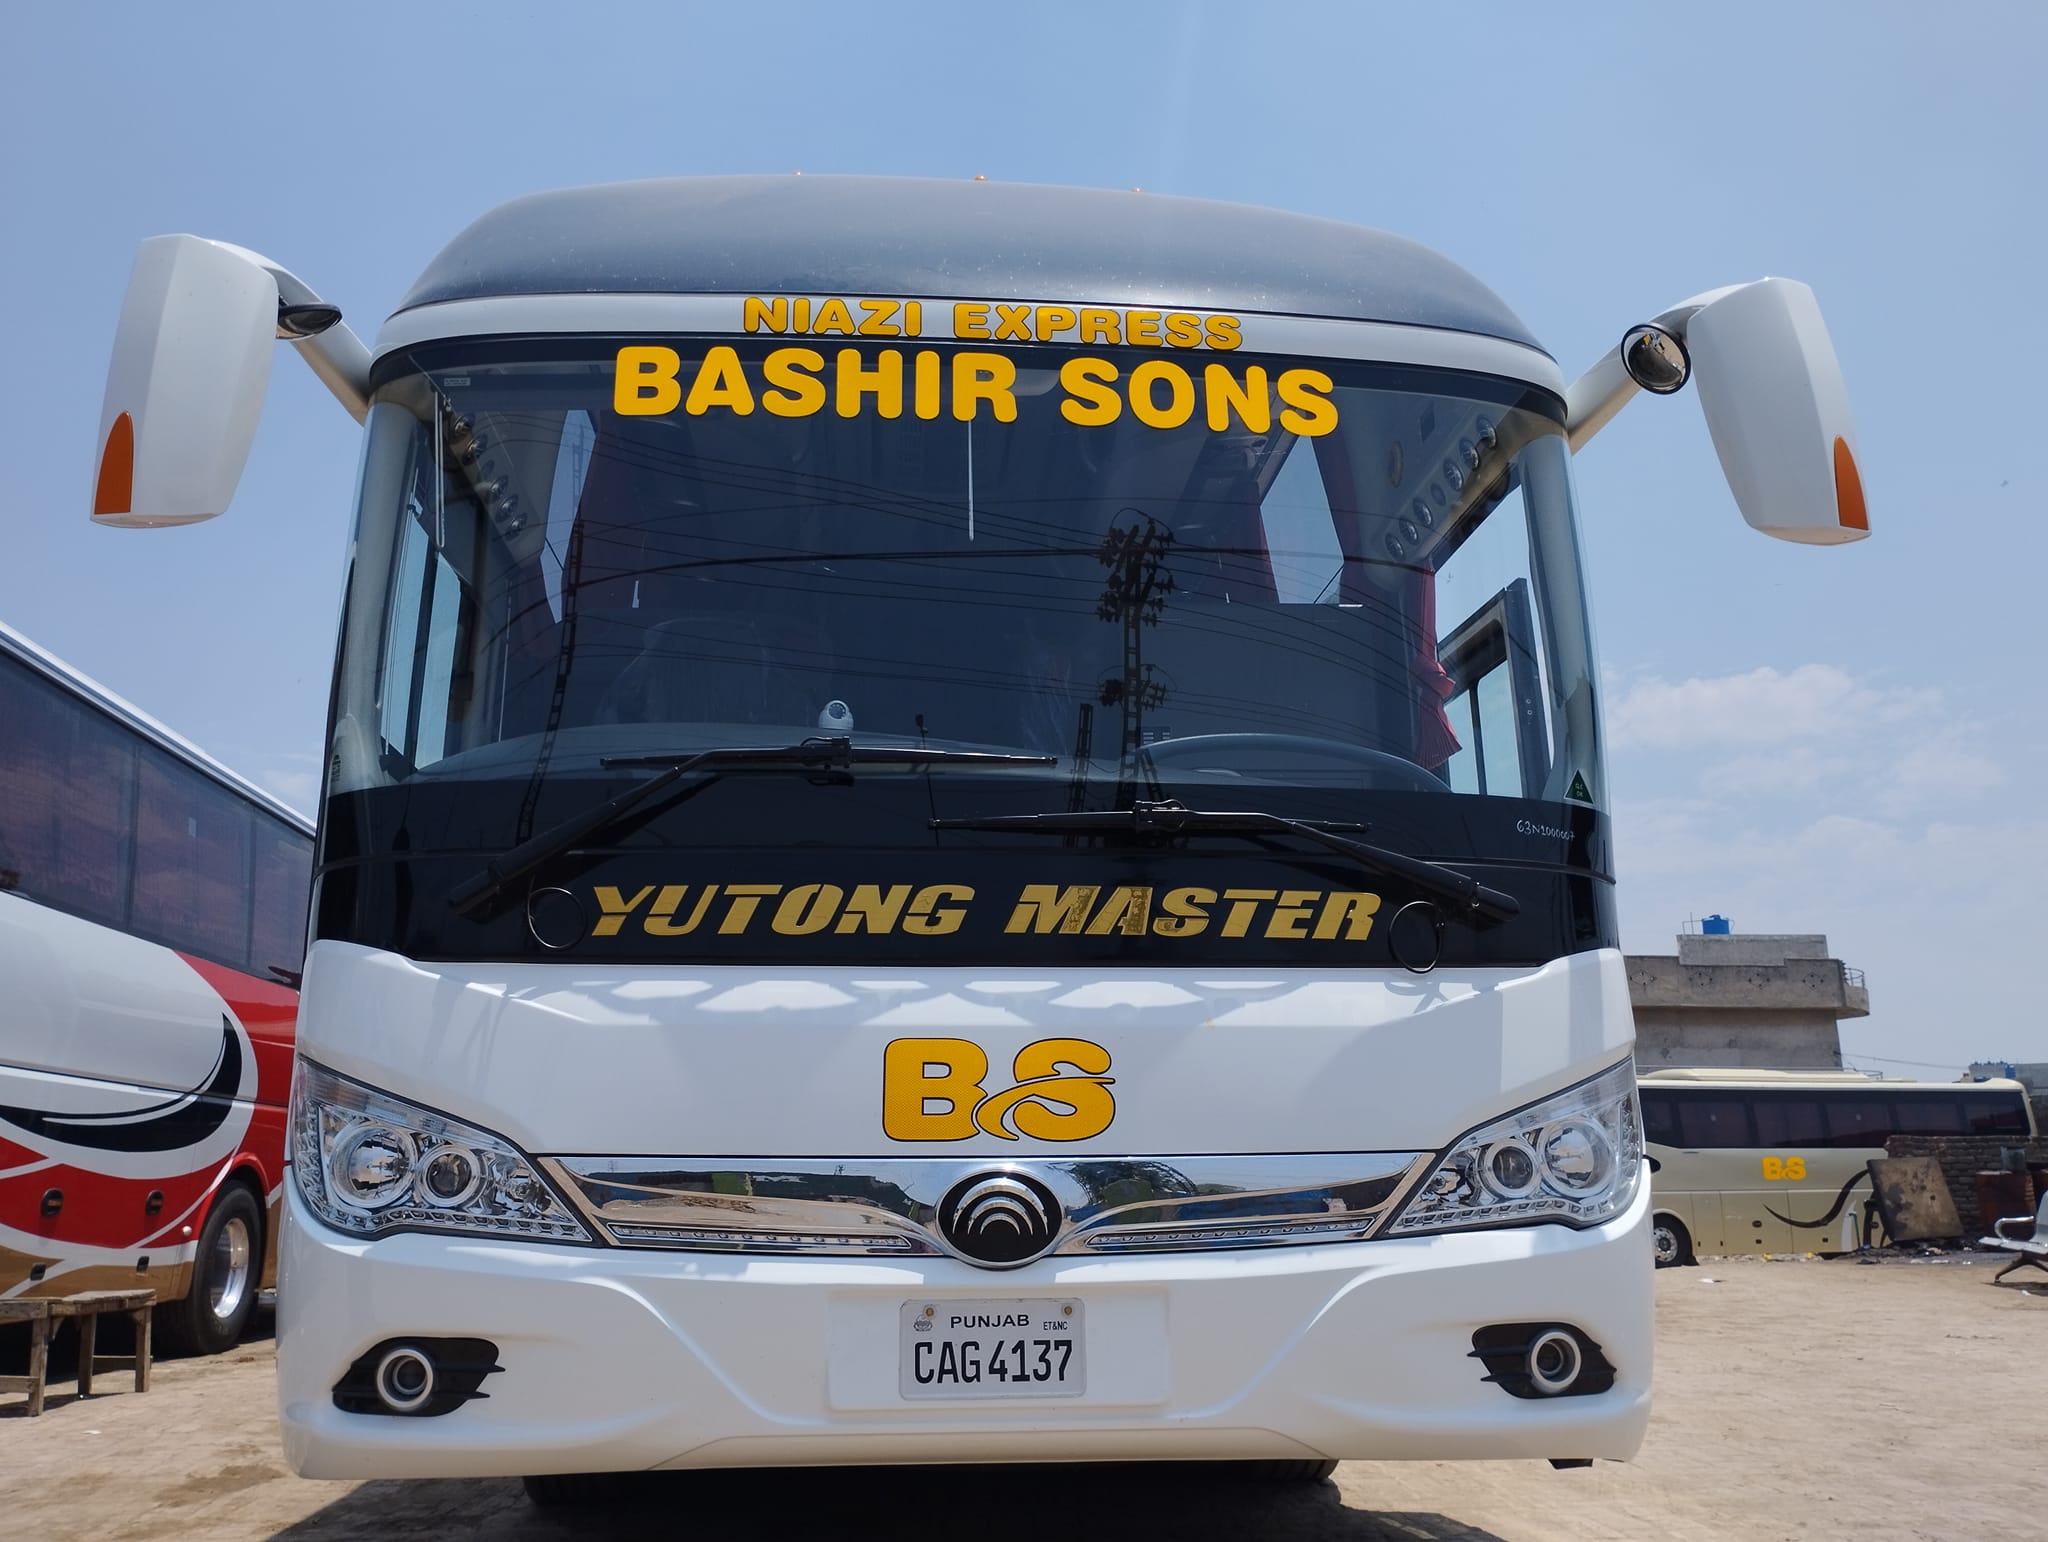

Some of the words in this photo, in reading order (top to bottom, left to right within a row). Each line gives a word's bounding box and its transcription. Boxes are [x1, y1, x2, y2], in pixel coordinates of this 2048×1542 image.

[743, 296, 922, 337] NIAZI
[953, 303, 1242, 350] EXPRESS
[613, 346, 1018, 422] BASHIR
[1060, 357, 1339, 437] SONS
[592, 884, 975, 937] YUTONG
[1003, 884, 1382, 941] MASTER
[950, 1314, 1030, 1329] PUNJAB
[914, 1340, 982, 1384] CAG
[988, 1339, 1073, 1383] 4137
